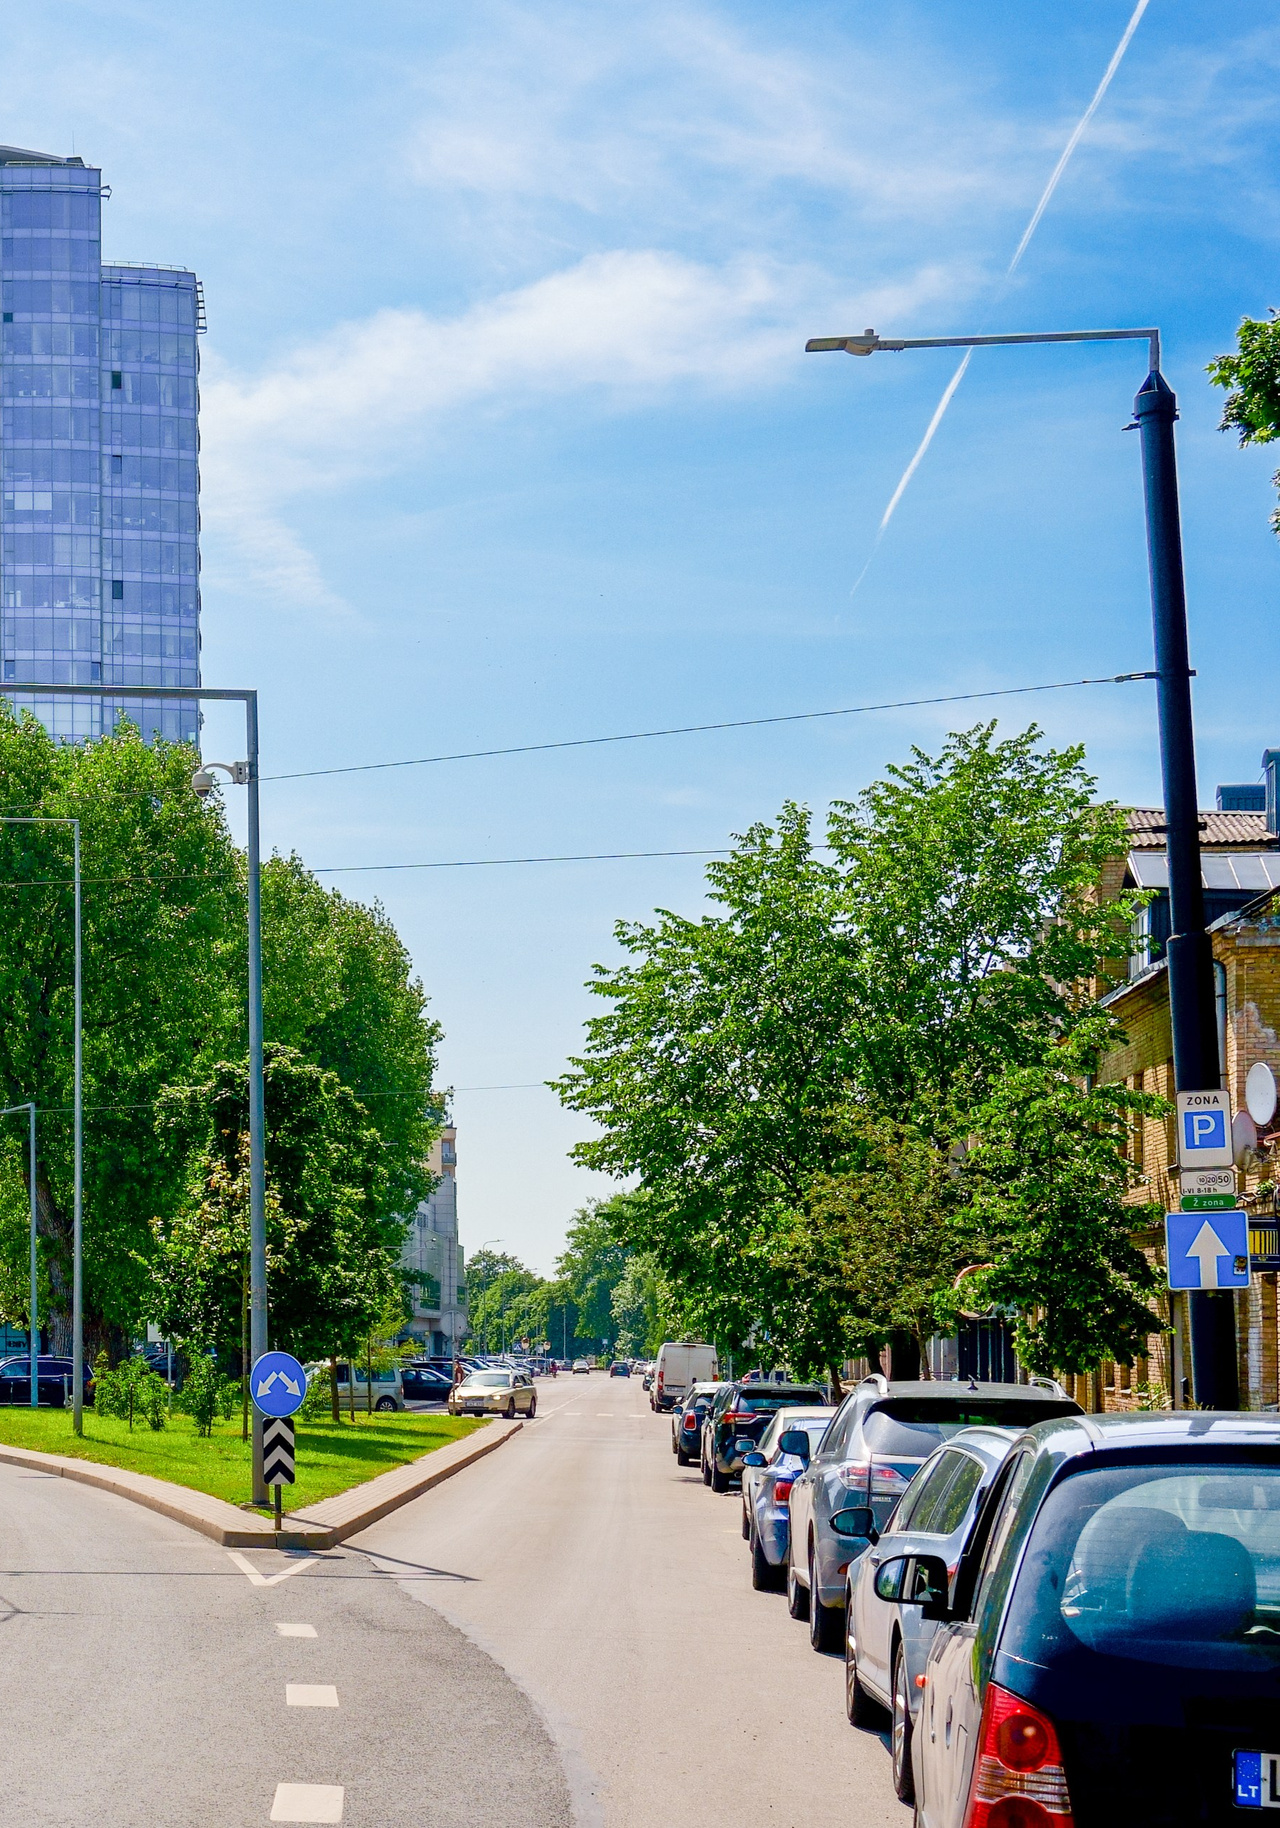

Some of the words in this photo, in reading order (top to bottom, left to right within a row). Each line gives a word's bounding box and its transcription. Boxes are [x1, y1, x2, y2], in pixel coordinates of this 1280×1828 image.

[1187, 1096, 1220, 1105] ZONA
[1193, 1115, 1216, 1145] P
[1217, 1175, 1229, 1183] 50
[1193, 1197, 1199, 1207] Ž
[1238, 1784, 1259, 1798] LT
